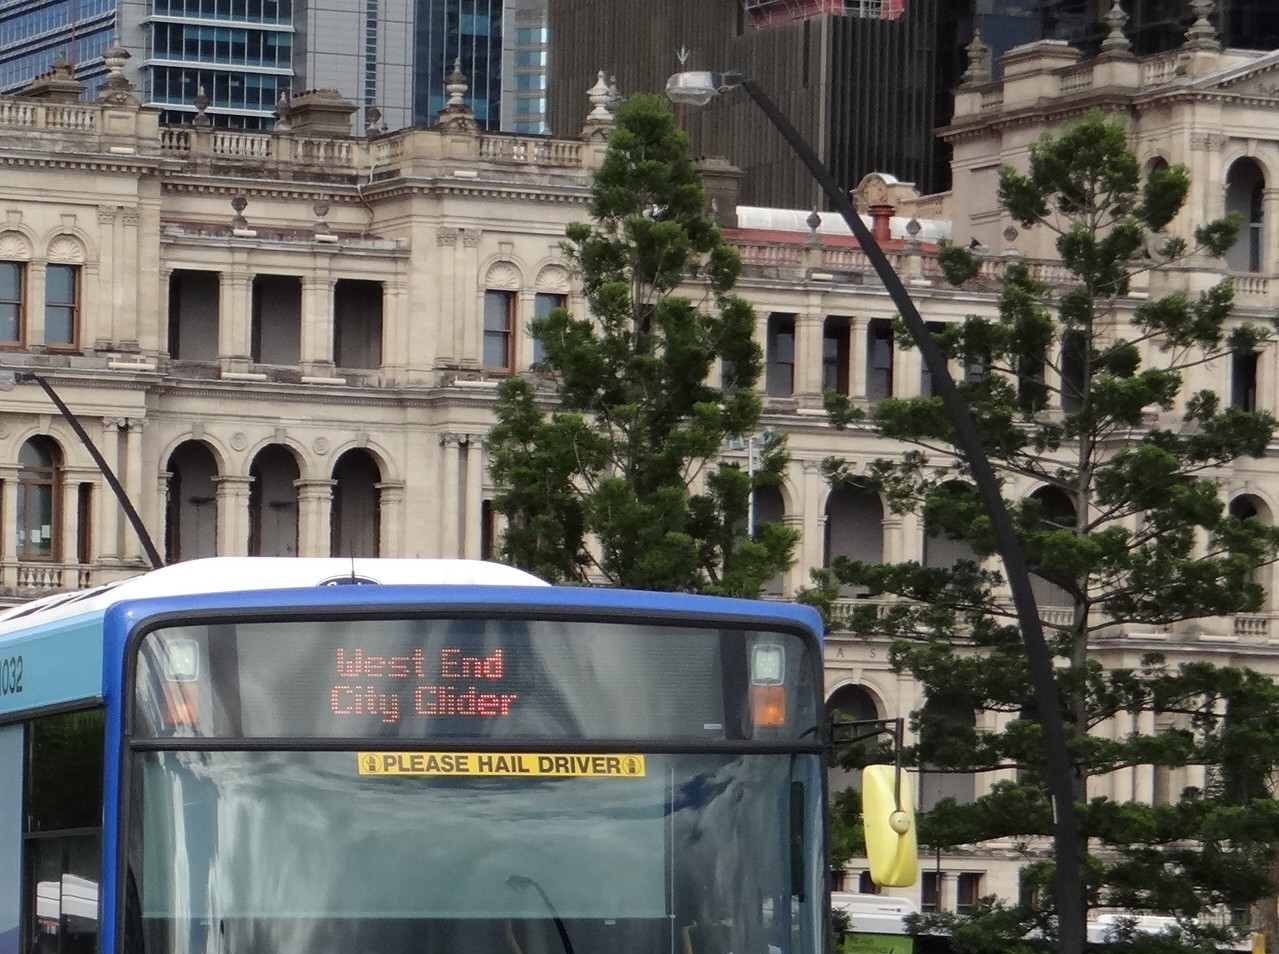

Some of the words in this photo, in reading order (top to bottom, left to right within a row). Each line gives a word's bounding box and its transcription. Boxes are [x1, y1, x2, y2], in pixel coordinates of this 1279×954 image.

[337, 648, 424, 678] West
[442, 648, 504, 678] End
[331, 685, 399, 723] City
[415, 685, 517, 716] Glider
[383, 755, 469, 773] PLEASE
[478, 755, 530, 773] HAIL
[538, 755, 621, 773] DRIVER
